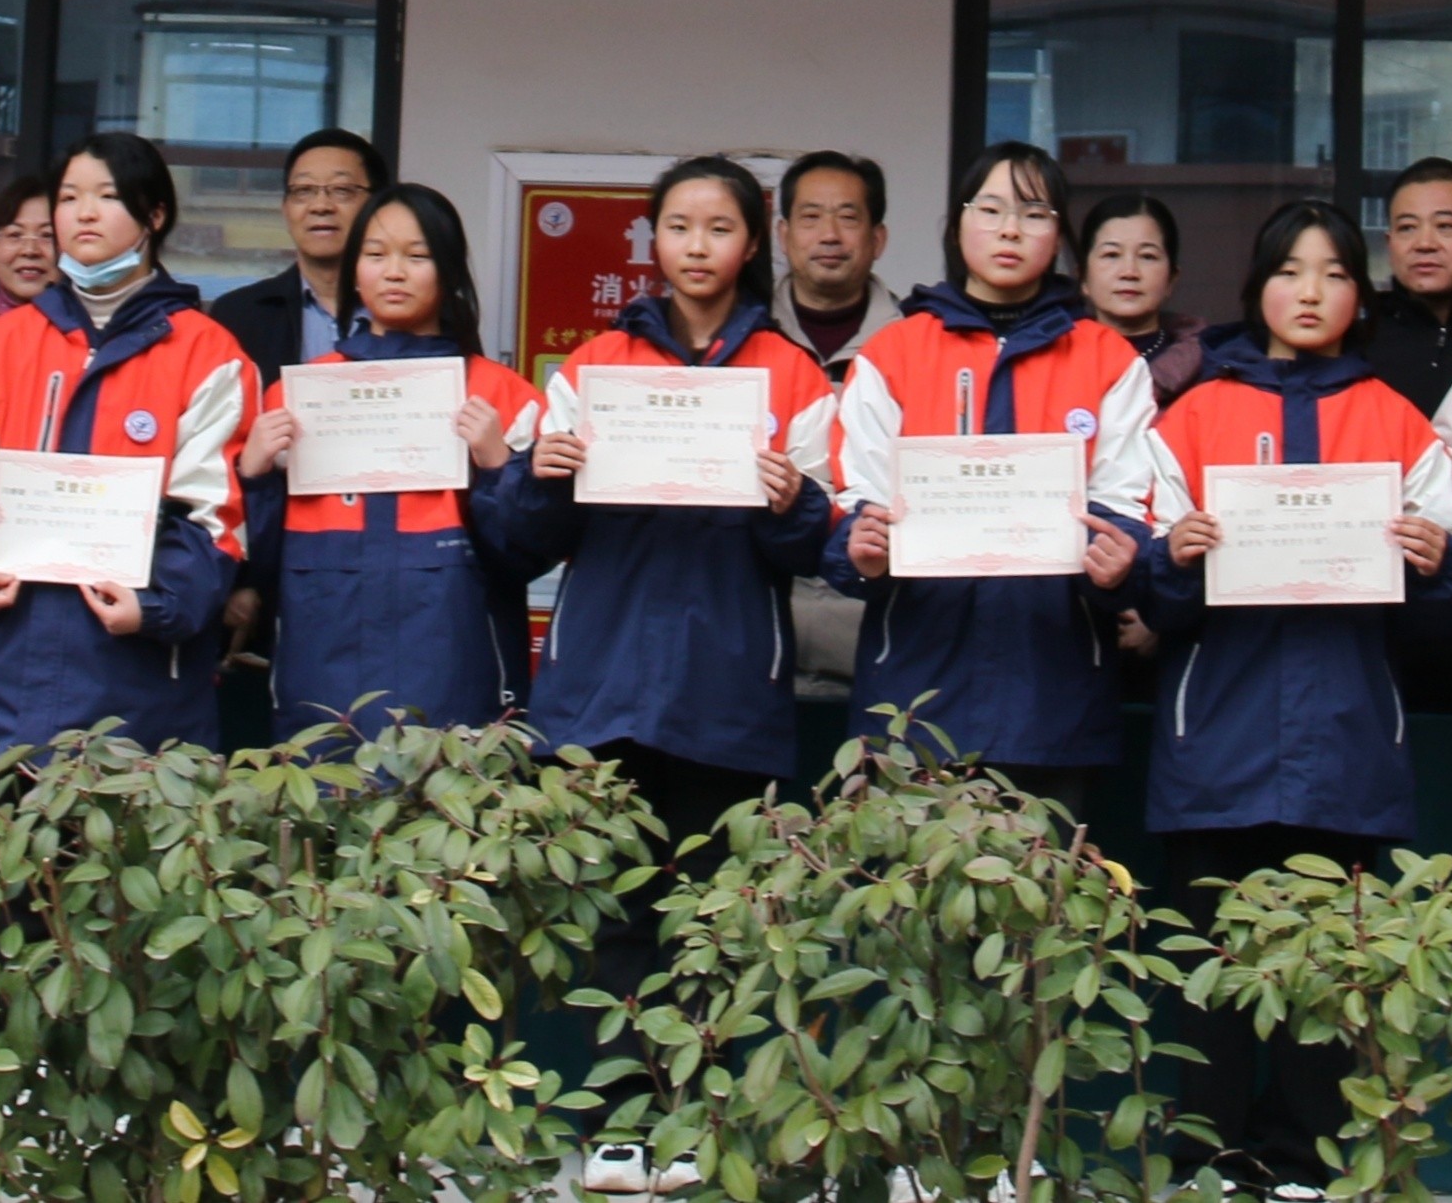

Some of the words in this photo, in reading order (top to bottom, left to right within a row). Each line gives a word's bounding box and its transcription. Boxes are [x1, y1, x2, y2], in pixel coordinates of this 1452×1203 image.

[591, 273, 674, 305] 消火
[647, 394, 702, 407] 荣誉证书
[959, 464, 1016, 477] 荣誉证书
[1276, 493, 1333, 506] 荣誉证书
